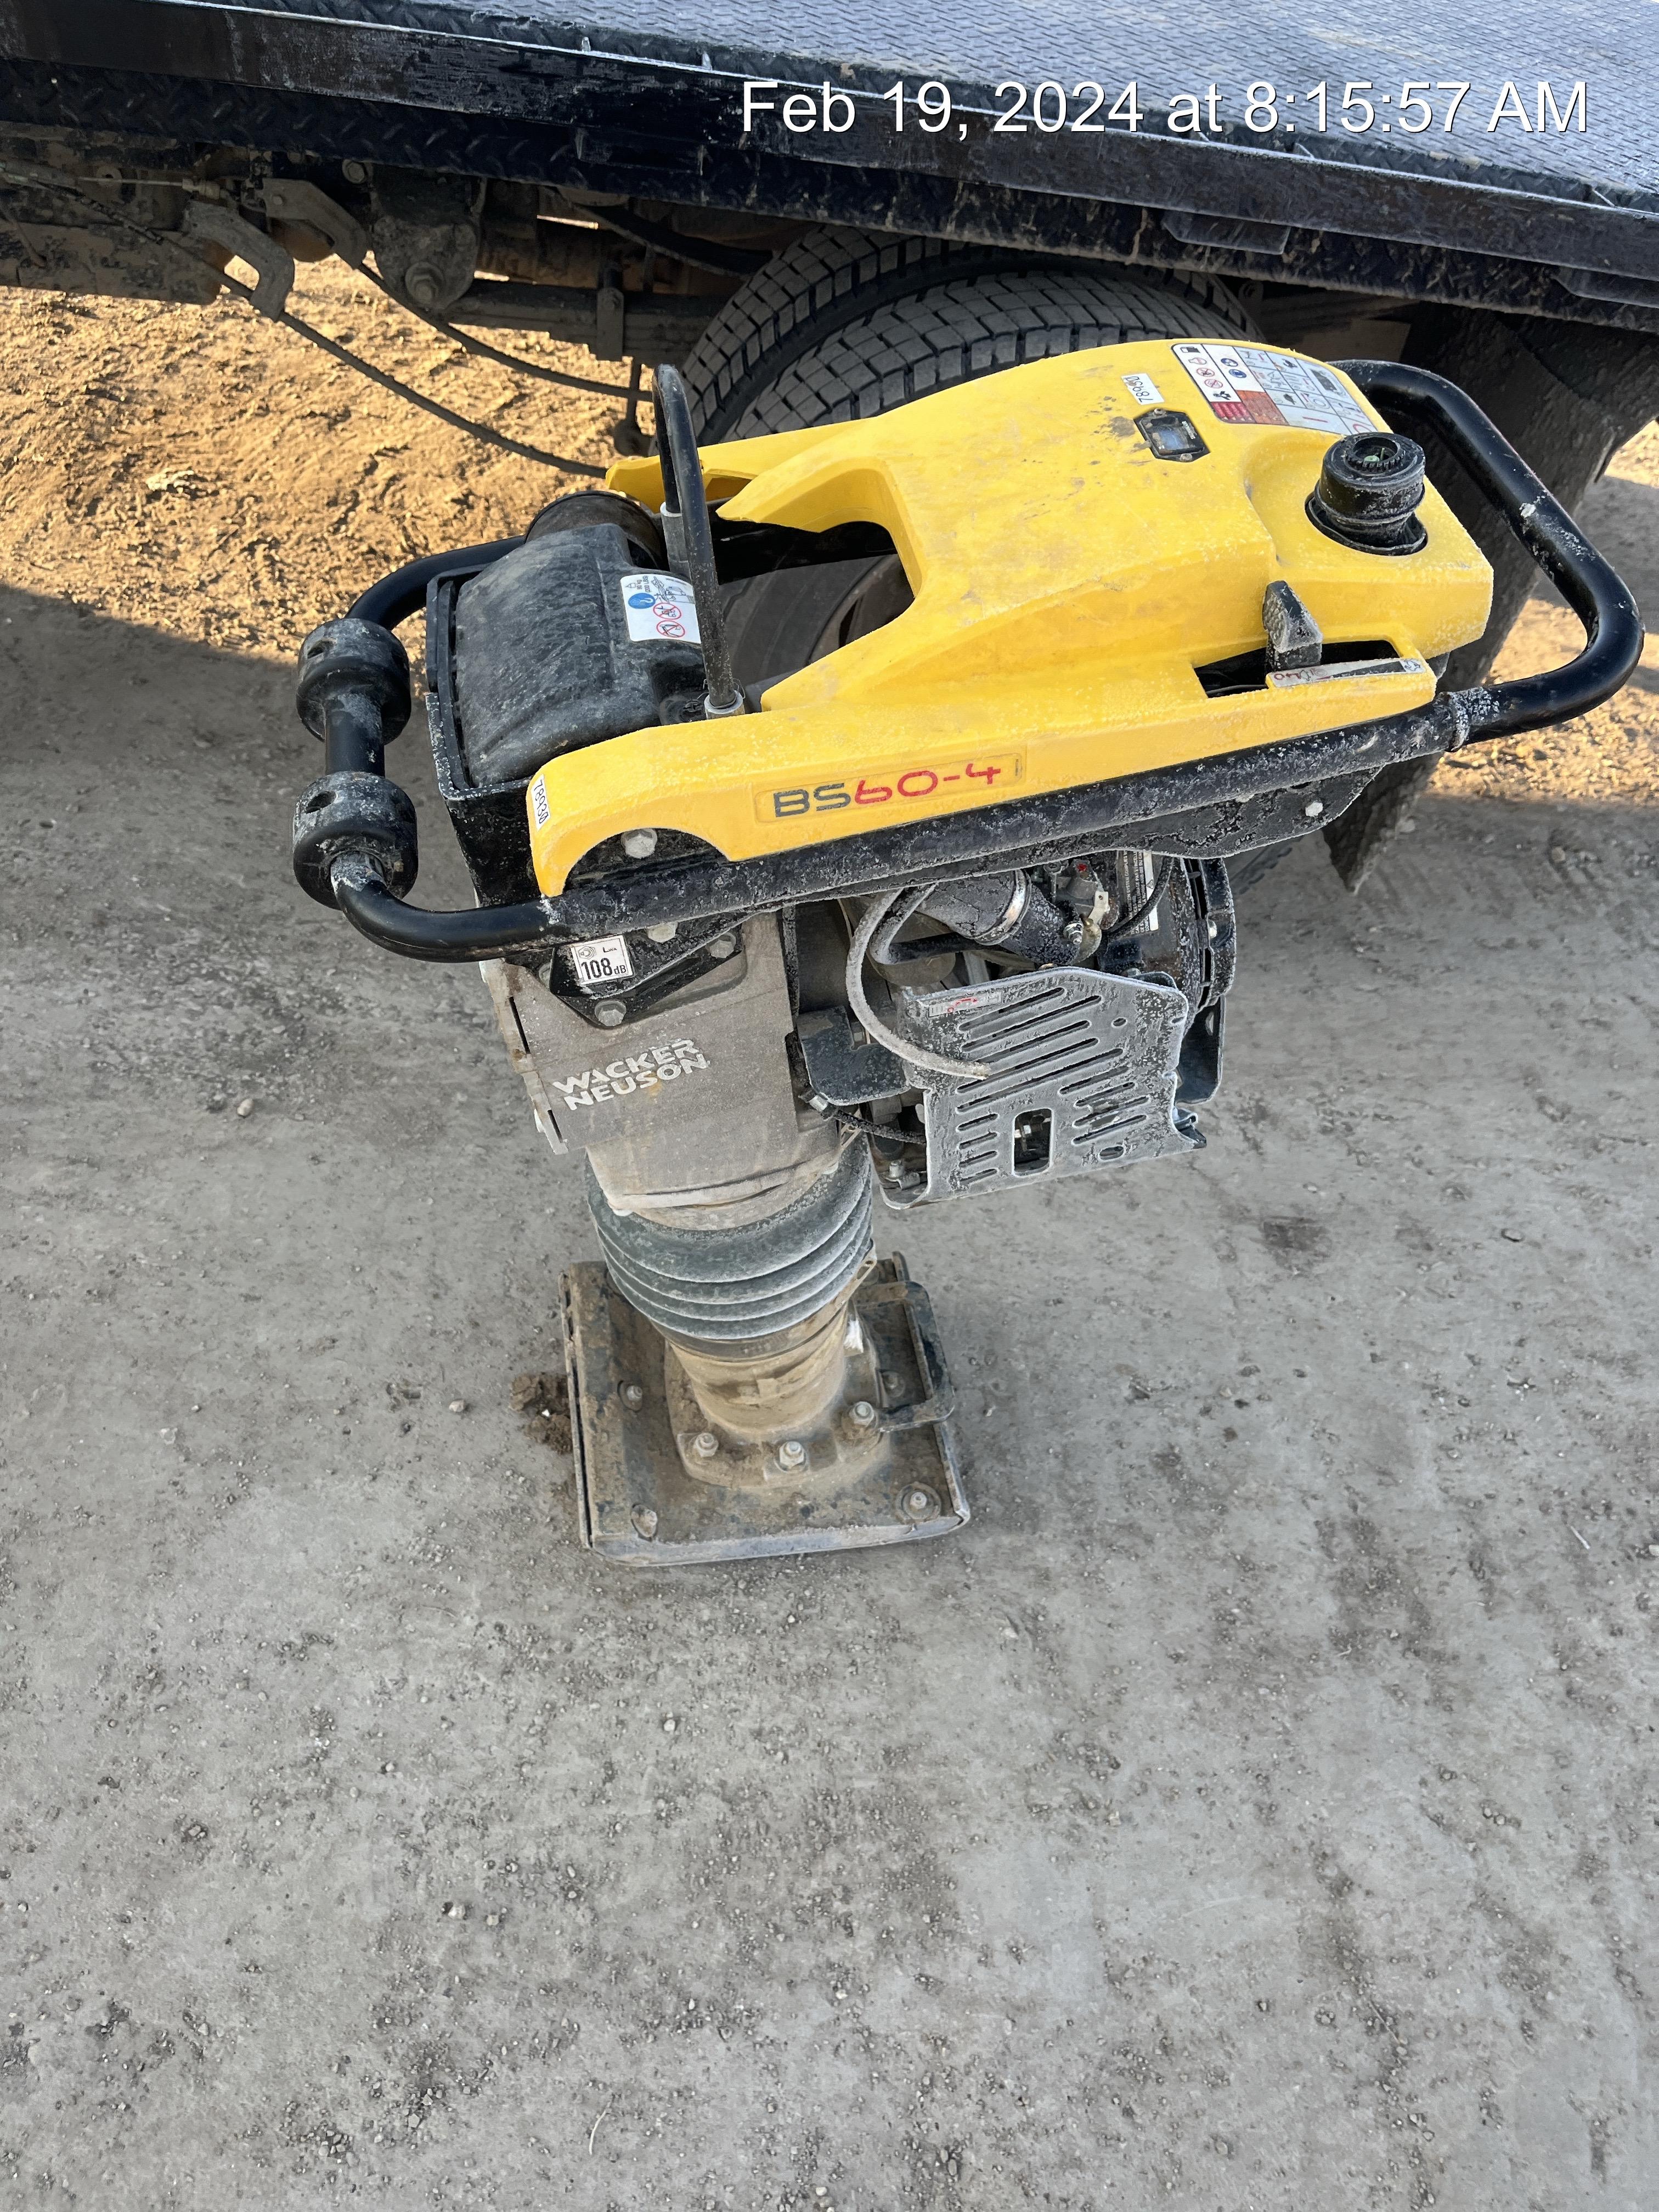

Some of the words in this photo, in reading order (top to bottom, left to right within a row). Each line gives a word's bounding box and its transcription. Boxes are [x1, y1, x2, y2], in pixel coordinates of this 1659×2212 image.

[773, 763, 1001, 818] BS60-4
[580, 957, 613, 980] 108
[613, 964, 627, 975] dB
[552, 1039, 701, 1094] WACKER
[563, 1053, 710, 1111] NEUSON
